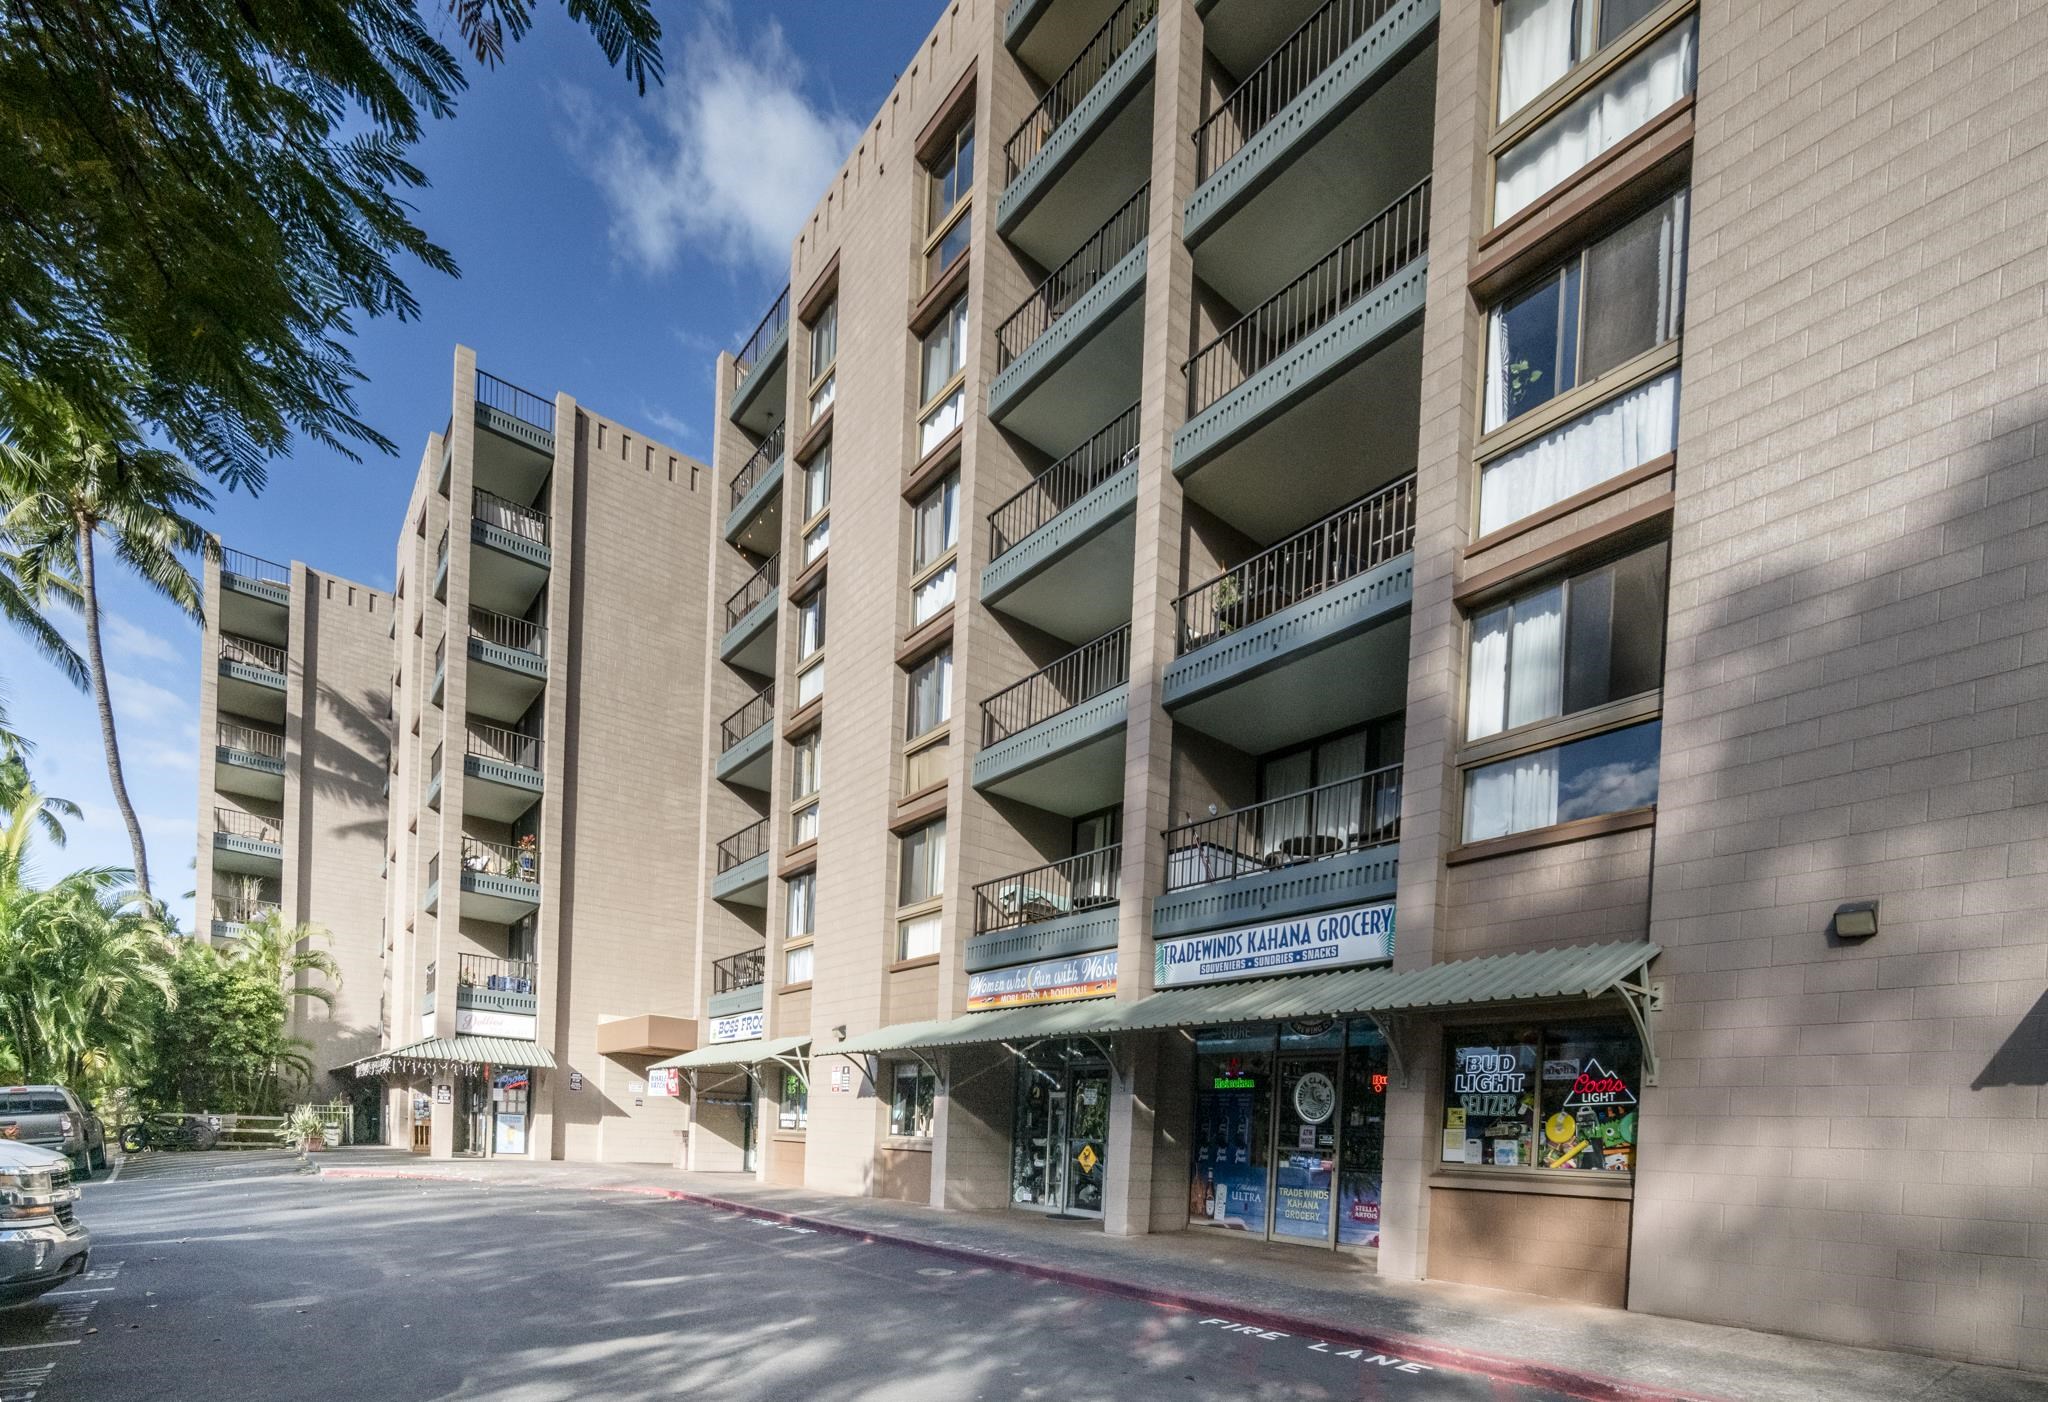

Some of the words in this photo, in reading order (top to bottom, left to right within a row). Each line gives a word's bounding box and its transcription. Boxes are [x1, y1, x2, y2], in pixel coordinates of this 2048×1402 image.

[1163, 930, 1242, 965] TRADEWINDS
[1247, 921, 1311, 954] KAHANA
[1317, 907, 1393, 942] GROCERY
[1201, 960, 1246, 974] SOUVENIERS
[1254, 952, 1294, 967] SUNDRIES
[1302, 947, 1337, 961] SNACKS
[970, 975, 1005, 996] Women
[1006, 970, 1027, 990] who
[1032, 970, 1052, 986] Run
[1054, 960, 1079, 985] with
[1001, 993, 1019, 1003] MORE
[1022, 990, 1040, 1000] THAN
[1043, 989, 1048, 999] A
[1051, 985, 1088, 997] BOUTIQUE
[718, 1019, 739, 1035] BOSS
[1465, 1054, 1516, 1074] BUD
[1573, 1073, 1626, 1094] Coors
[1460, 1093, 1517, 1117] SELTZER
[1582, 1092, 1616, 1103] LIGHT
[1231, 1190, 1261, 1202] ULTRA
[1279, 1186, 1329, 1200] TRADEWINDS
[1287, 1199, 1319, 1210] KAHANA
[1355, 1205, 1378, 1213] STELLA
[1284, 1210, 1321, 1222] GROCERY
[1354, 1211, 1378, 1219] ARTOIS
[1198, 1318, 1291, 1341] FIRE
[1307, 1341, 1434, 1374] LANE
